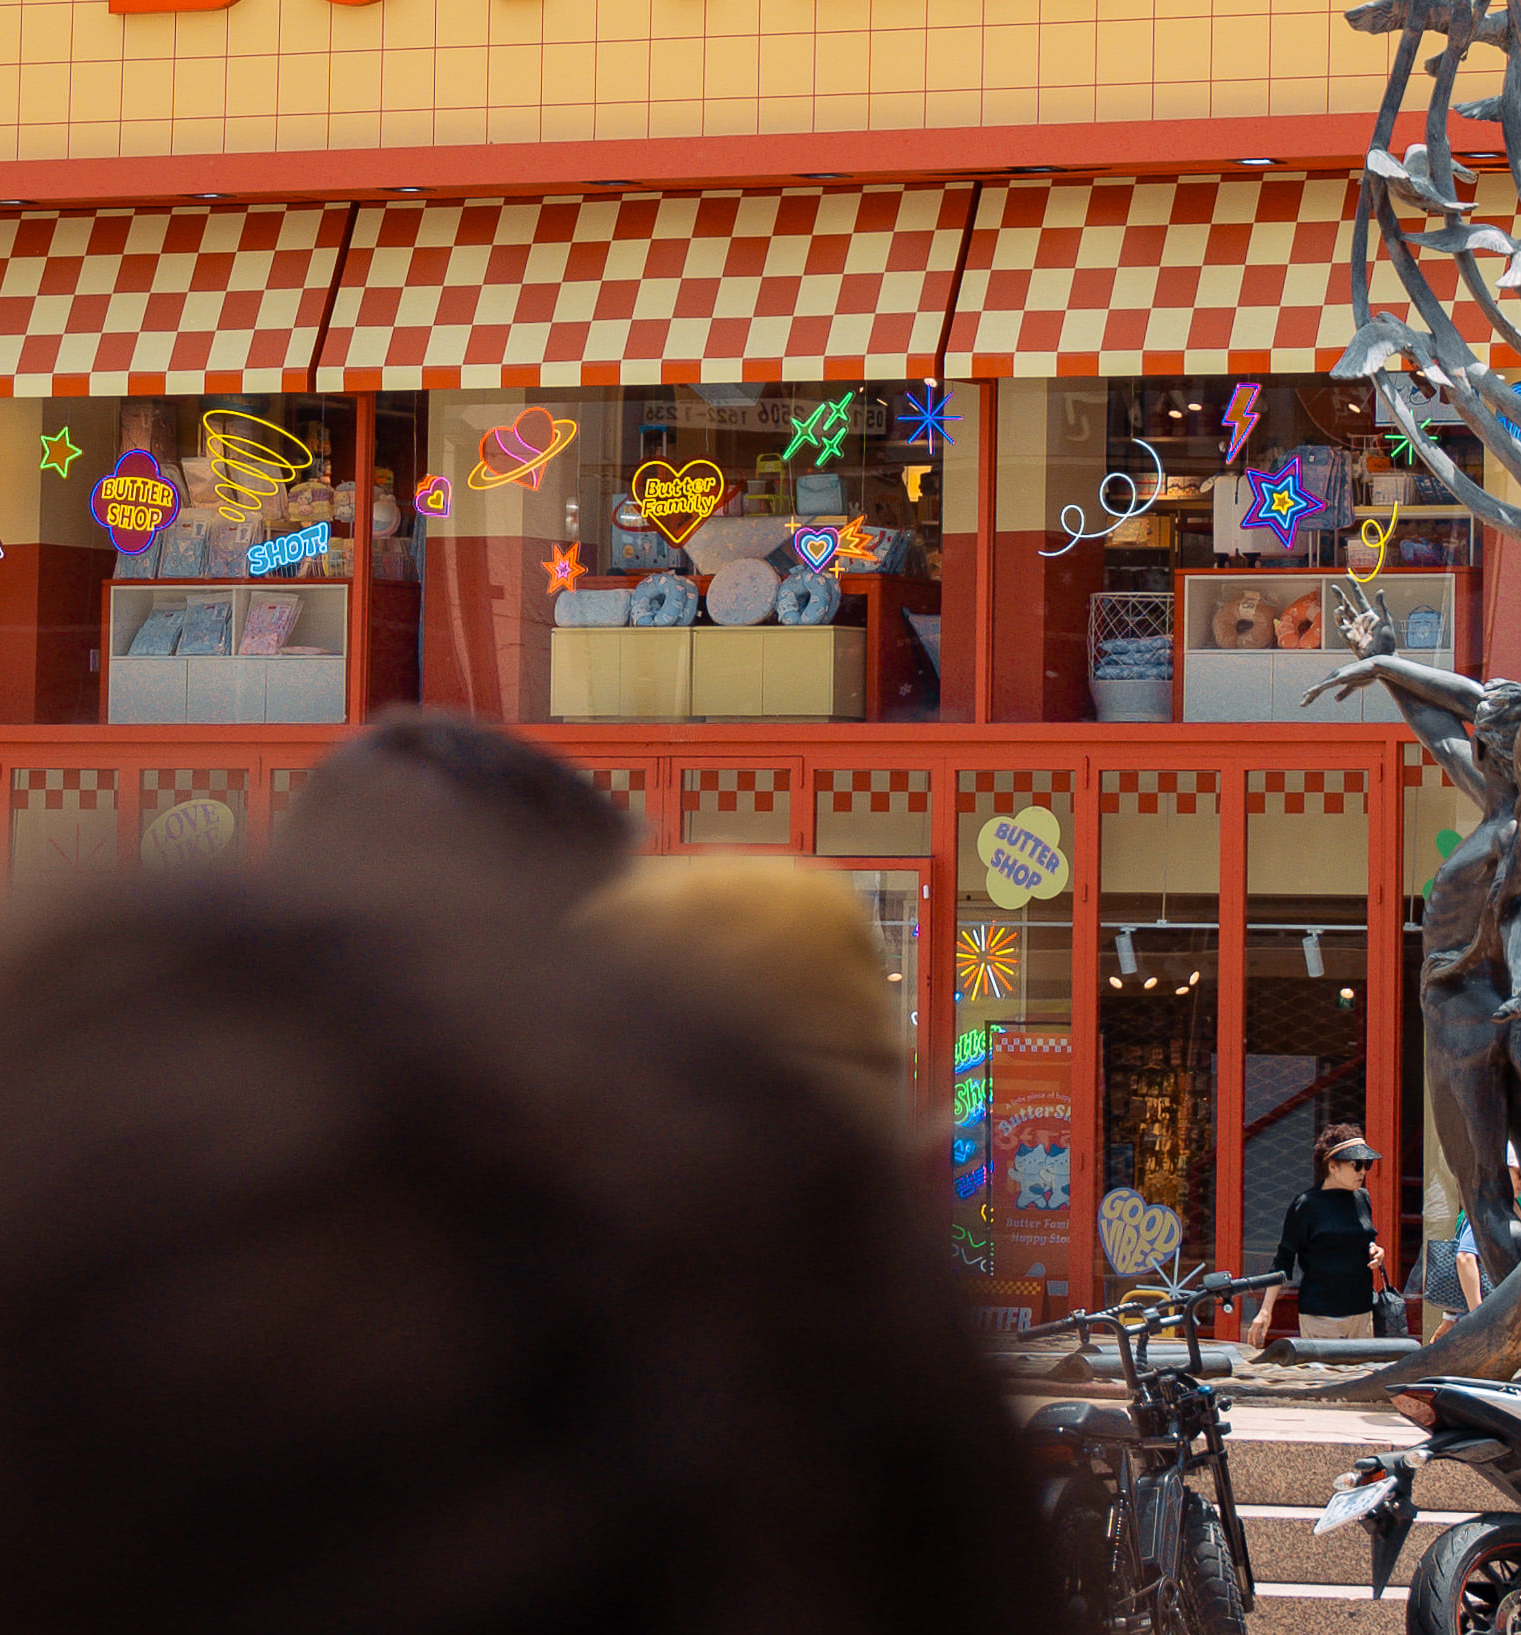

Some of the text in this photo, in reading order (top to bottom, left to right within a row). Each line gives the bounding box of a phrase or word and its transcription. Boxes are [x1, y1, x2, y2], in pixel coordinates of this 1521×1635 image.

[101, 478, 173, 508] BUTTER
[641, 493, 715, 518] Family
[645, 477, 716, 498] Butter
[107, 503, 162, 531] SHOP
[248, 522, 329, 575] SHOT!
[995, 822, 1060, 875] BUTTER
[990, 848, 1043, 890] SHOP
[1102, 1191, 1179, 1253] GOOD
